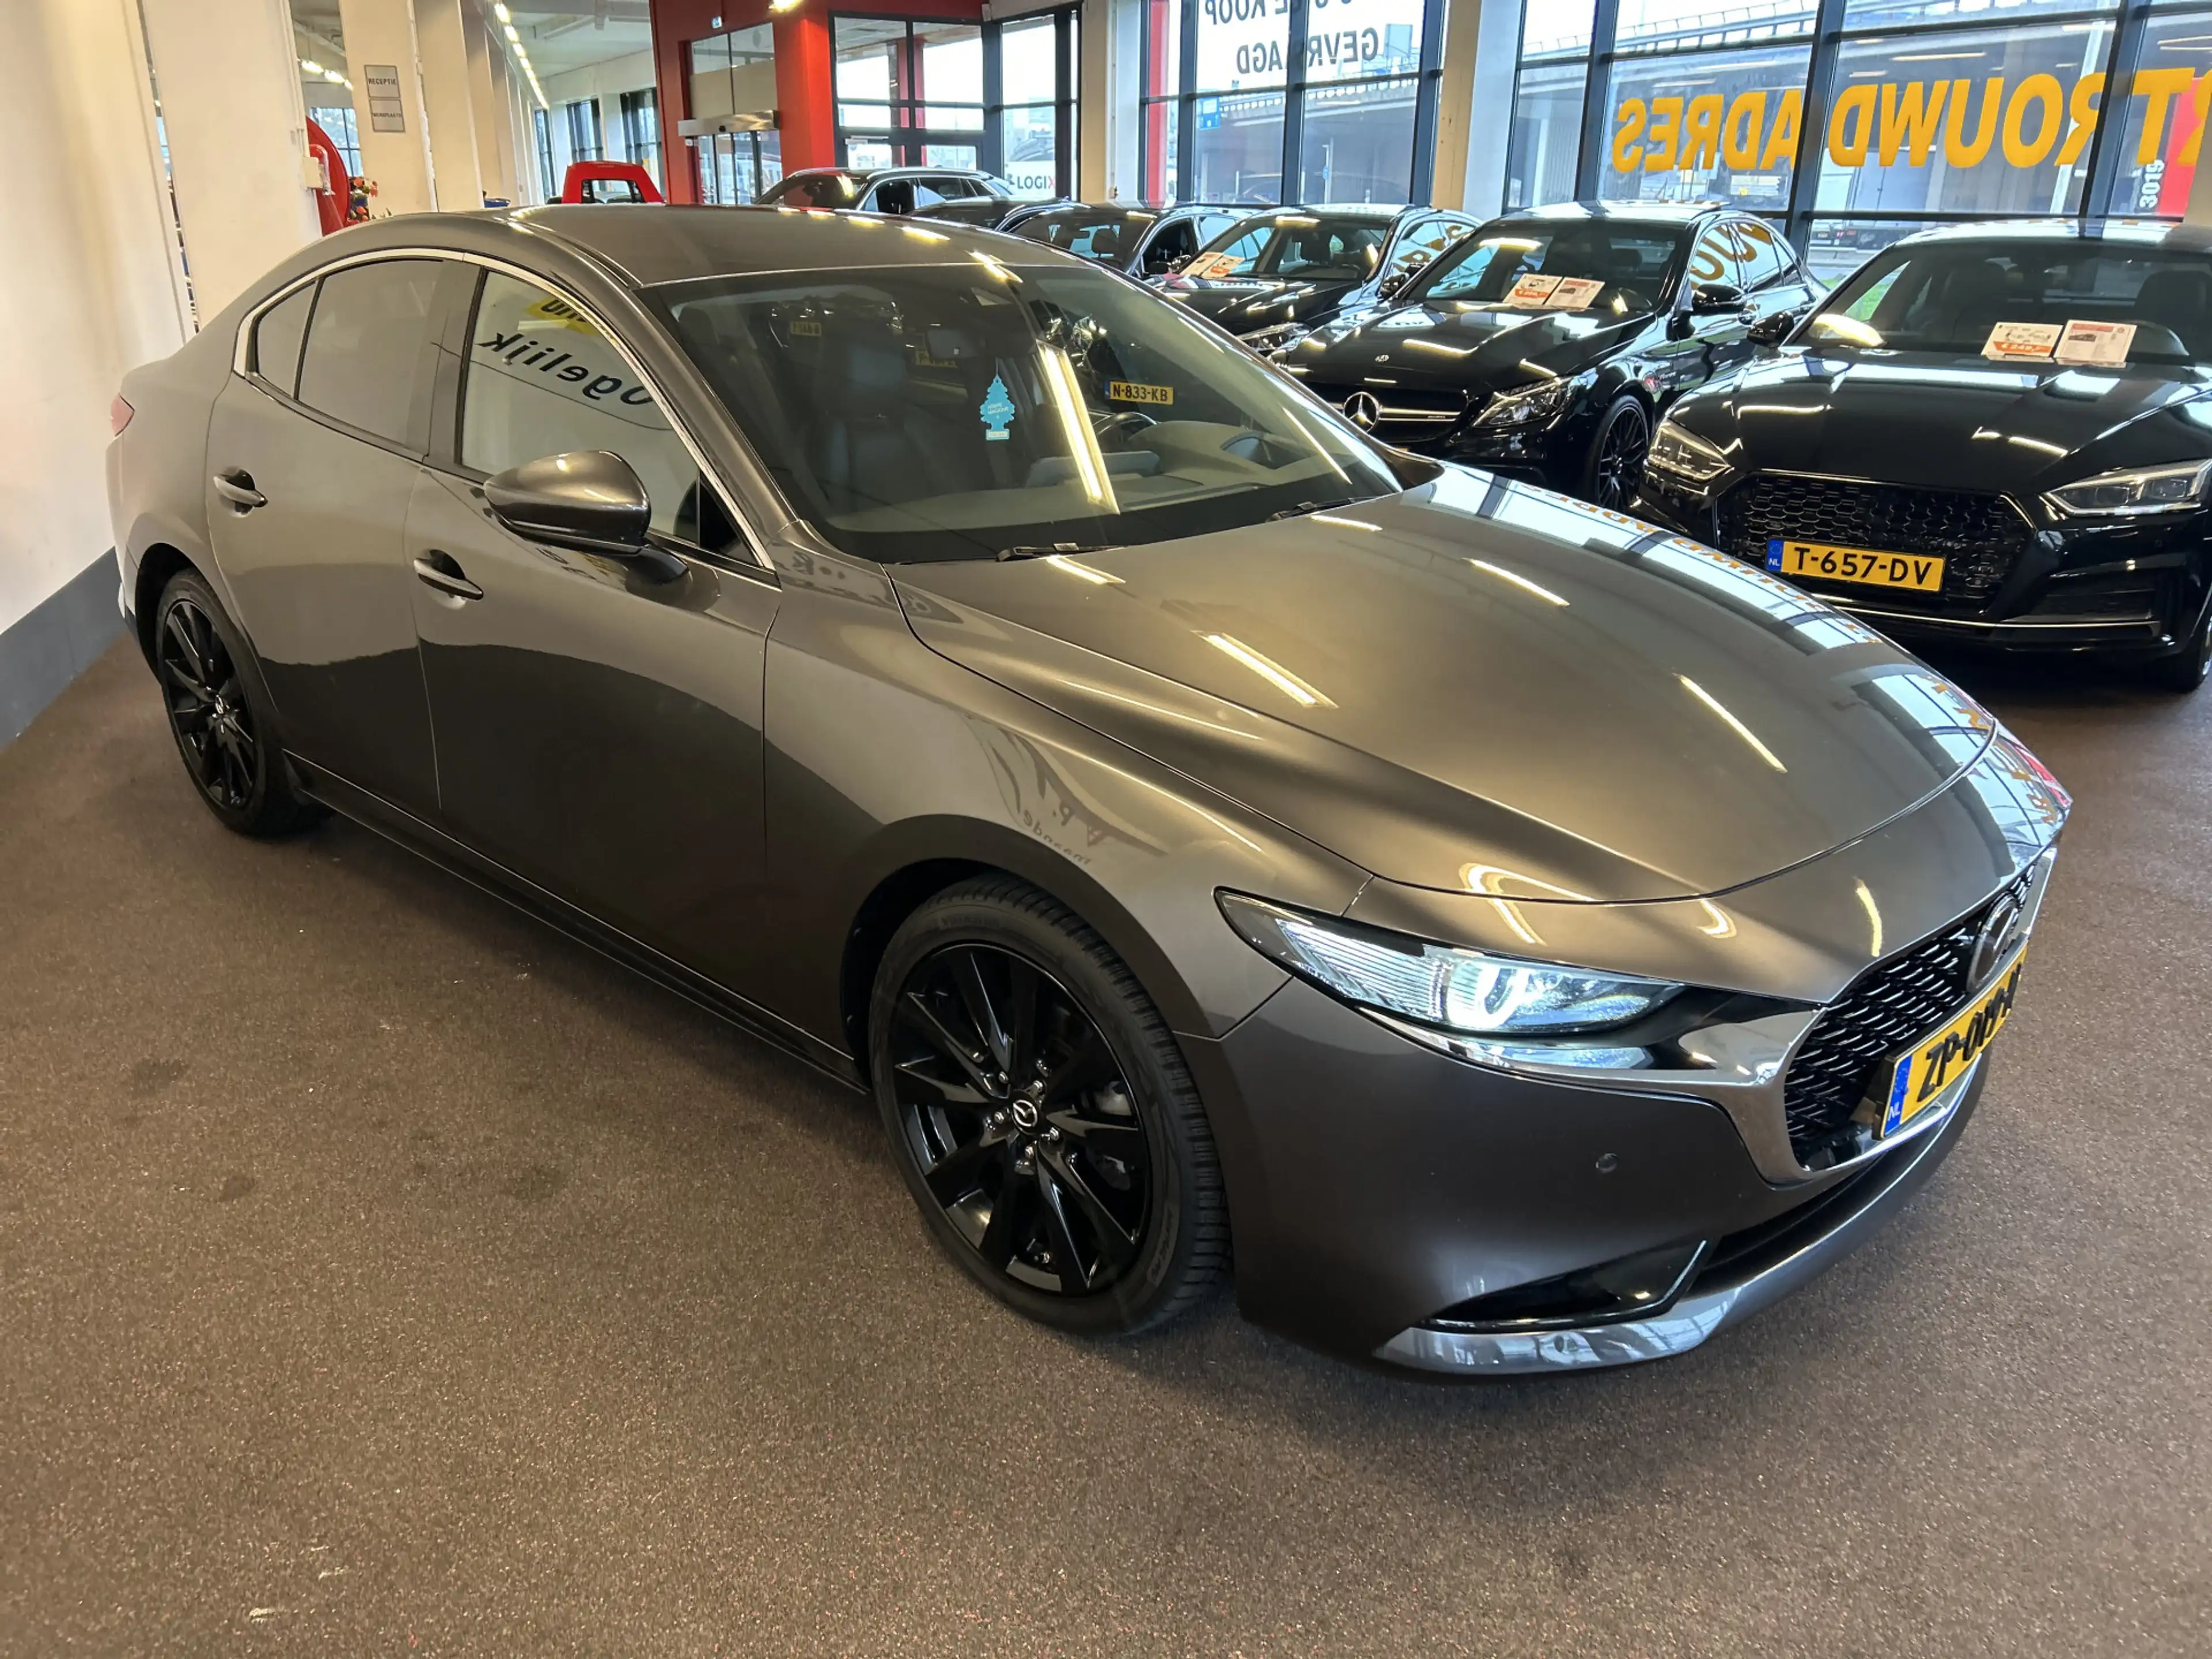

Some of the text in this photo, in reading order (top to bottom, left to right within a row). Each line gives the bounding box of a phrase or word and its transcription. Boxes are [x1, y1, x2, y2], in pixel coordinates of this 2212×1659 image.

[2139, 160, 2165, 208] 3019
[1113, 384, 1168, 402] N-833-KB
[1768, 547, 1932, 585] NL T-657-DV
[1887, 1105, 1901, 1122] NL
